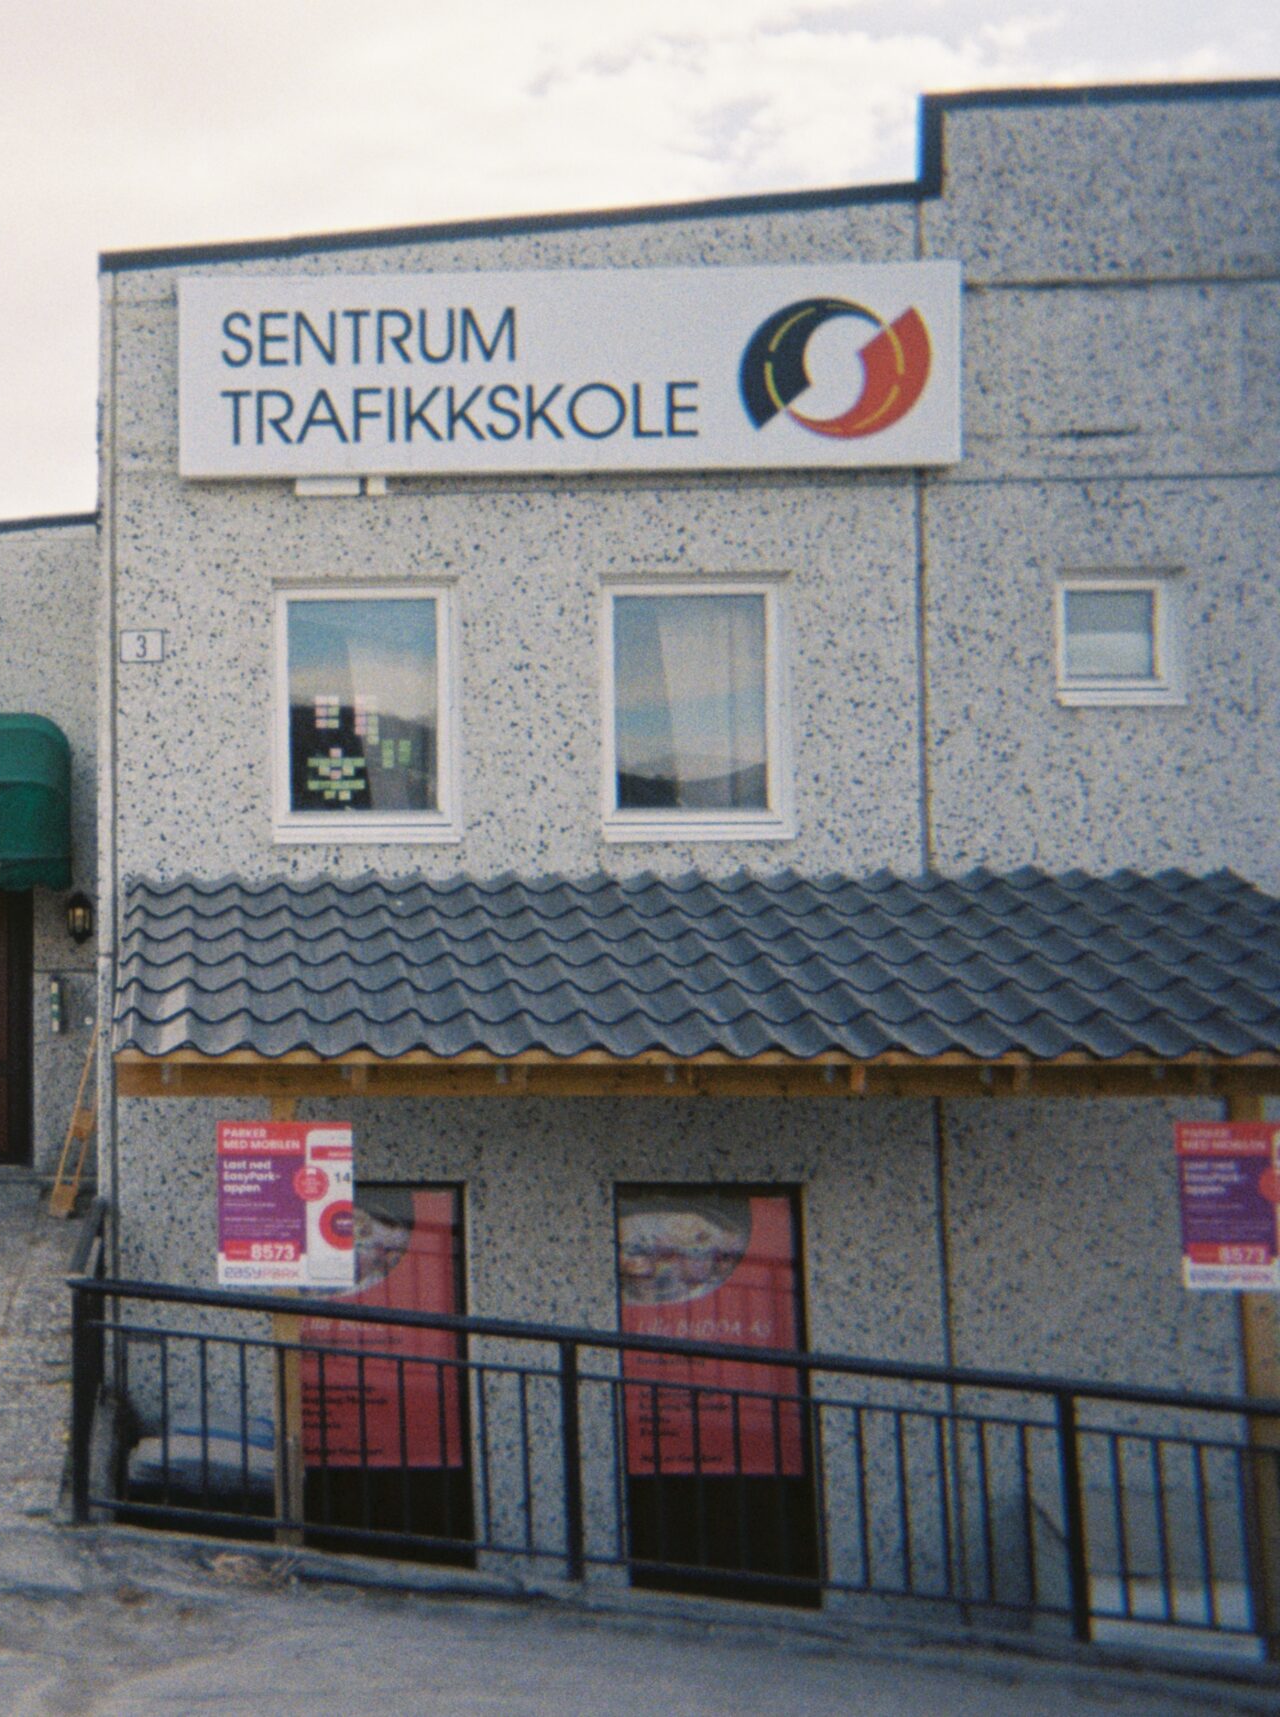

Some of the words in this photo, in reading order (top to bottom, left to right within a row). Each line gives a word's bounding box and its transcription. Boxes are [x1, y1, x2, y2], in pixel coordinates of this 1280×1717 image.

[221, 306, 517, 369] SENTRUM
[221, 381, 700, 446] TRAFIKKSKOLE
[136, 634, 147, 658] 3
[222, 1128, 267, 1138] PARKER
